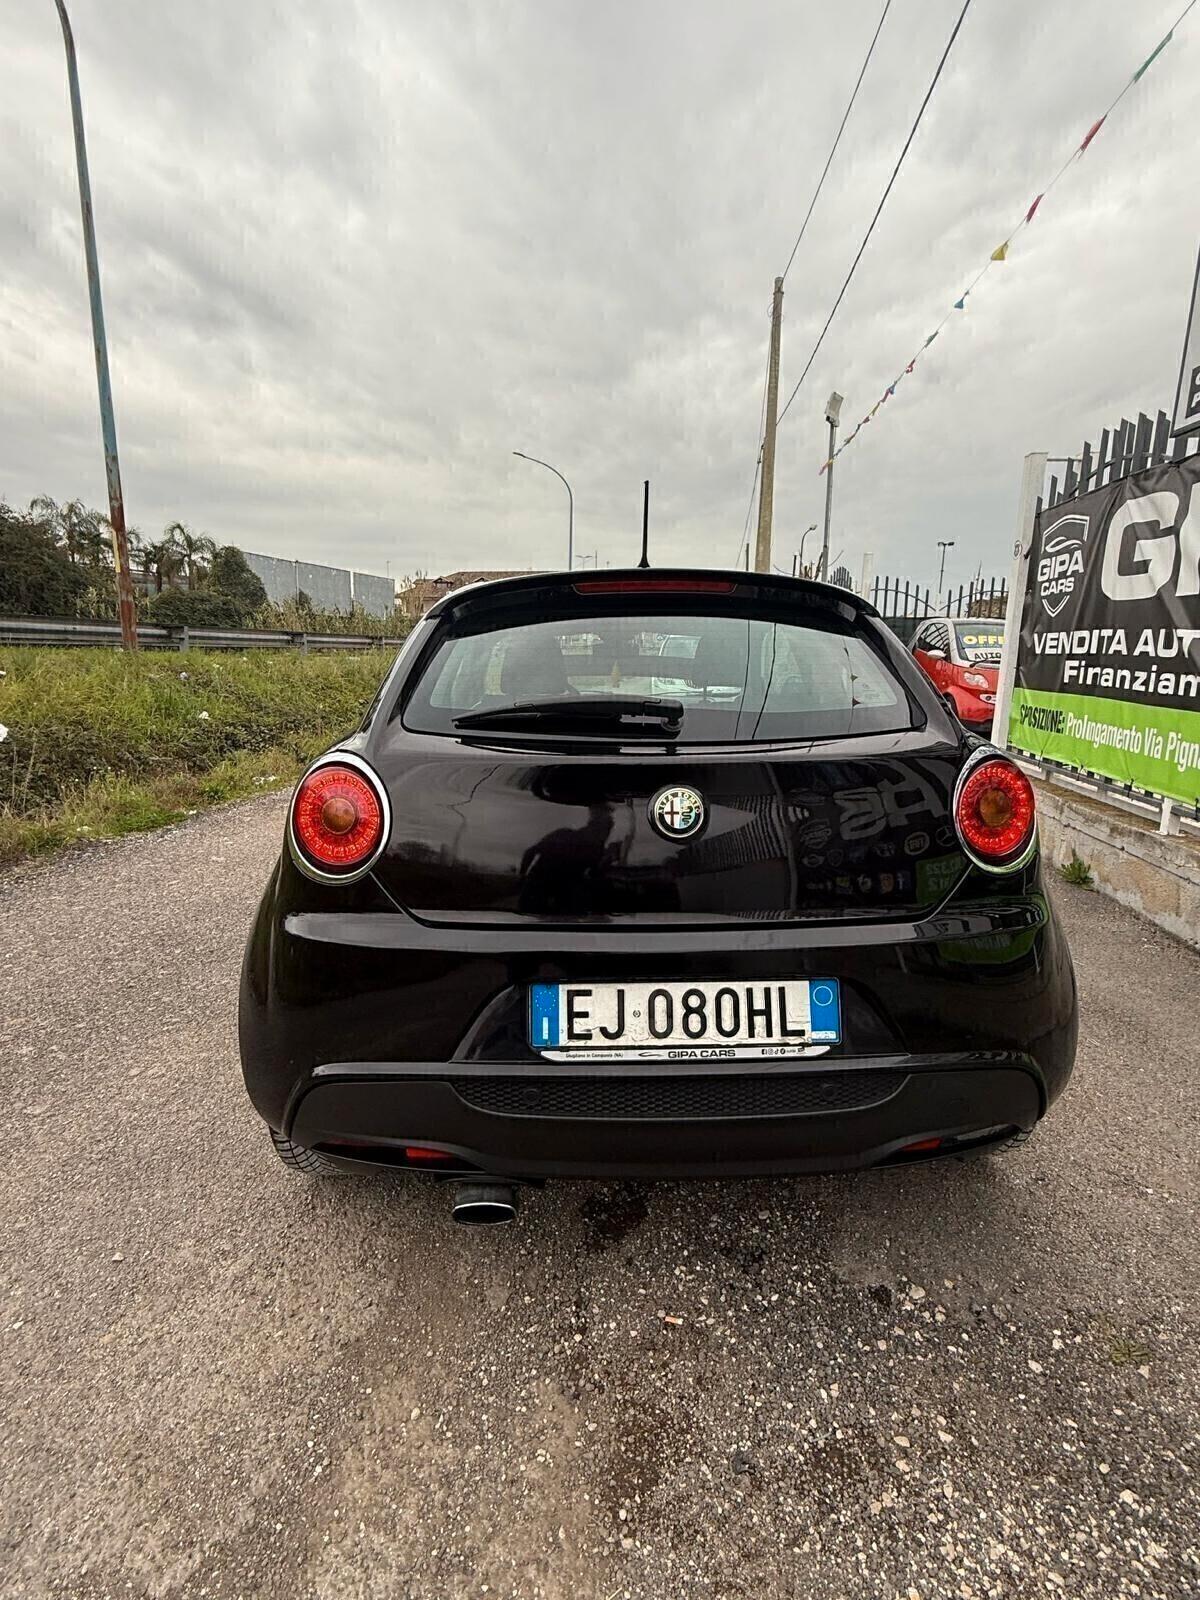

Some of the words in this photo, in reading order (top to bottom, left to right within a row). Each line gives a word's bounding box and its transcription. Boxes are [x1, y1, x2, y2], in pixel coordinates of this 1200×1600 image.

[1037, 550, 1084, 582] GIPA
[1040, 577, 1075, 596] CARS
[1033, 629, 1128, 655] VENDITA
[1066, 712, 1142, 754] Prolungamento
[1144, 727, 1163, 760] Via
[1165, 731, 1200, 772] Pign
[658, 794, 674, 814] ALFA
[678, 791, 700, 814] ROMEO
[566, 988, 625, 1041] EJ
[649, 986, 806, 1040] 080HL
[668, 1050, 698, 1059] GIPA
[700, 1049, 736, 1058] CARS
